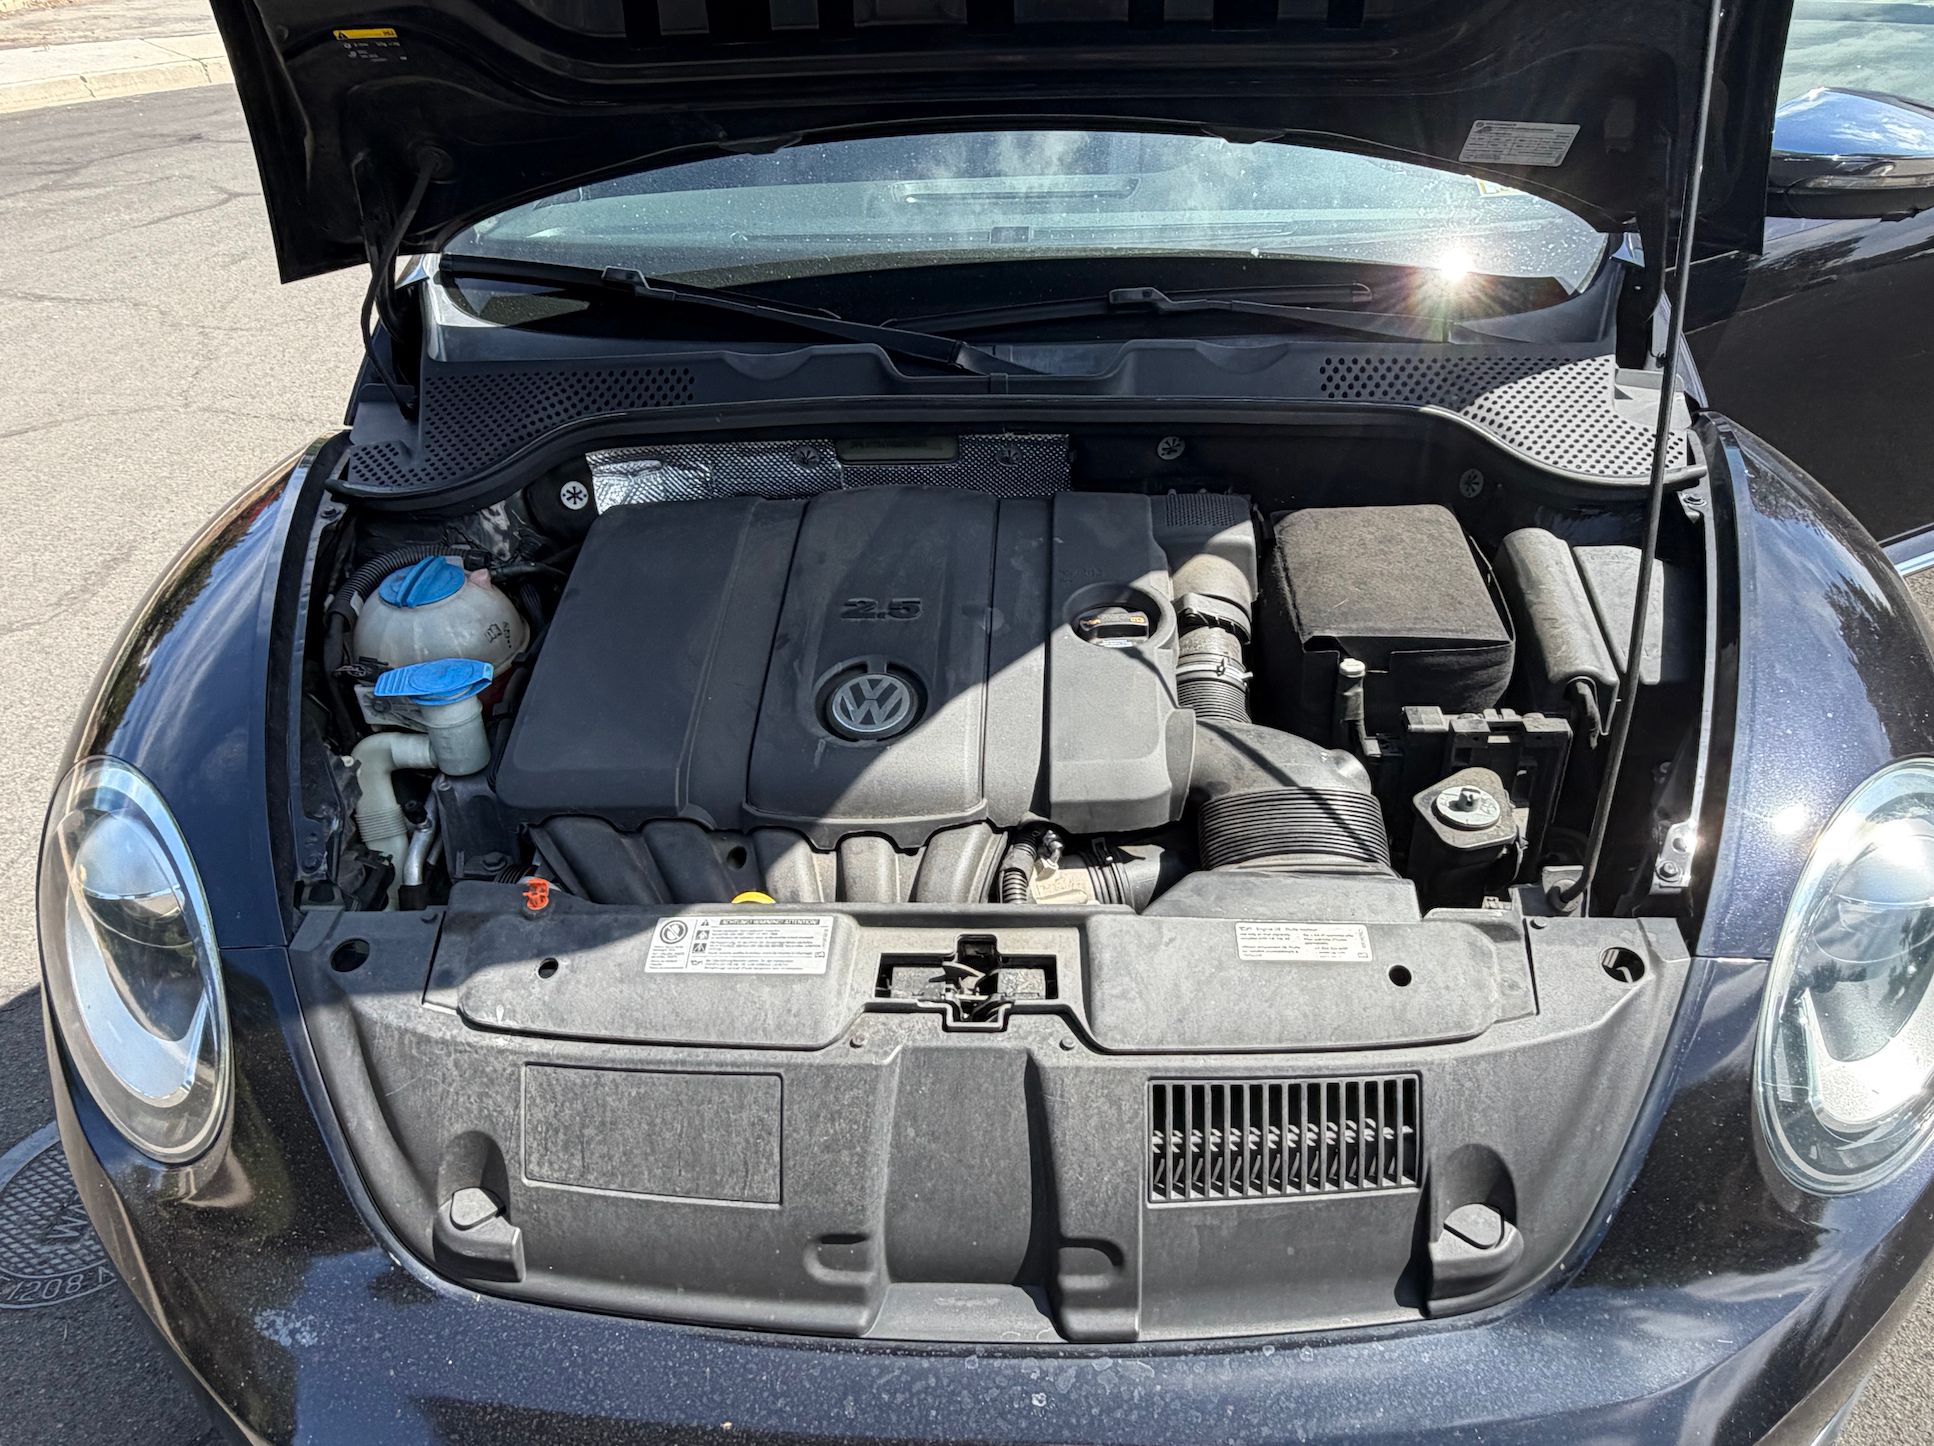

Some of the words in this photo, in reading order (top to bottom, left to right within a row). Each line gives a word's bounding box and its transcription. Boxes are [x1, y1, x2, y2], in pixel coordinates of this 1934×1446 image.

[841, 598, 922, 620] 2.5
[832, 674, 911, 733] VW
[7, 1273, 84, 1300] 1208
